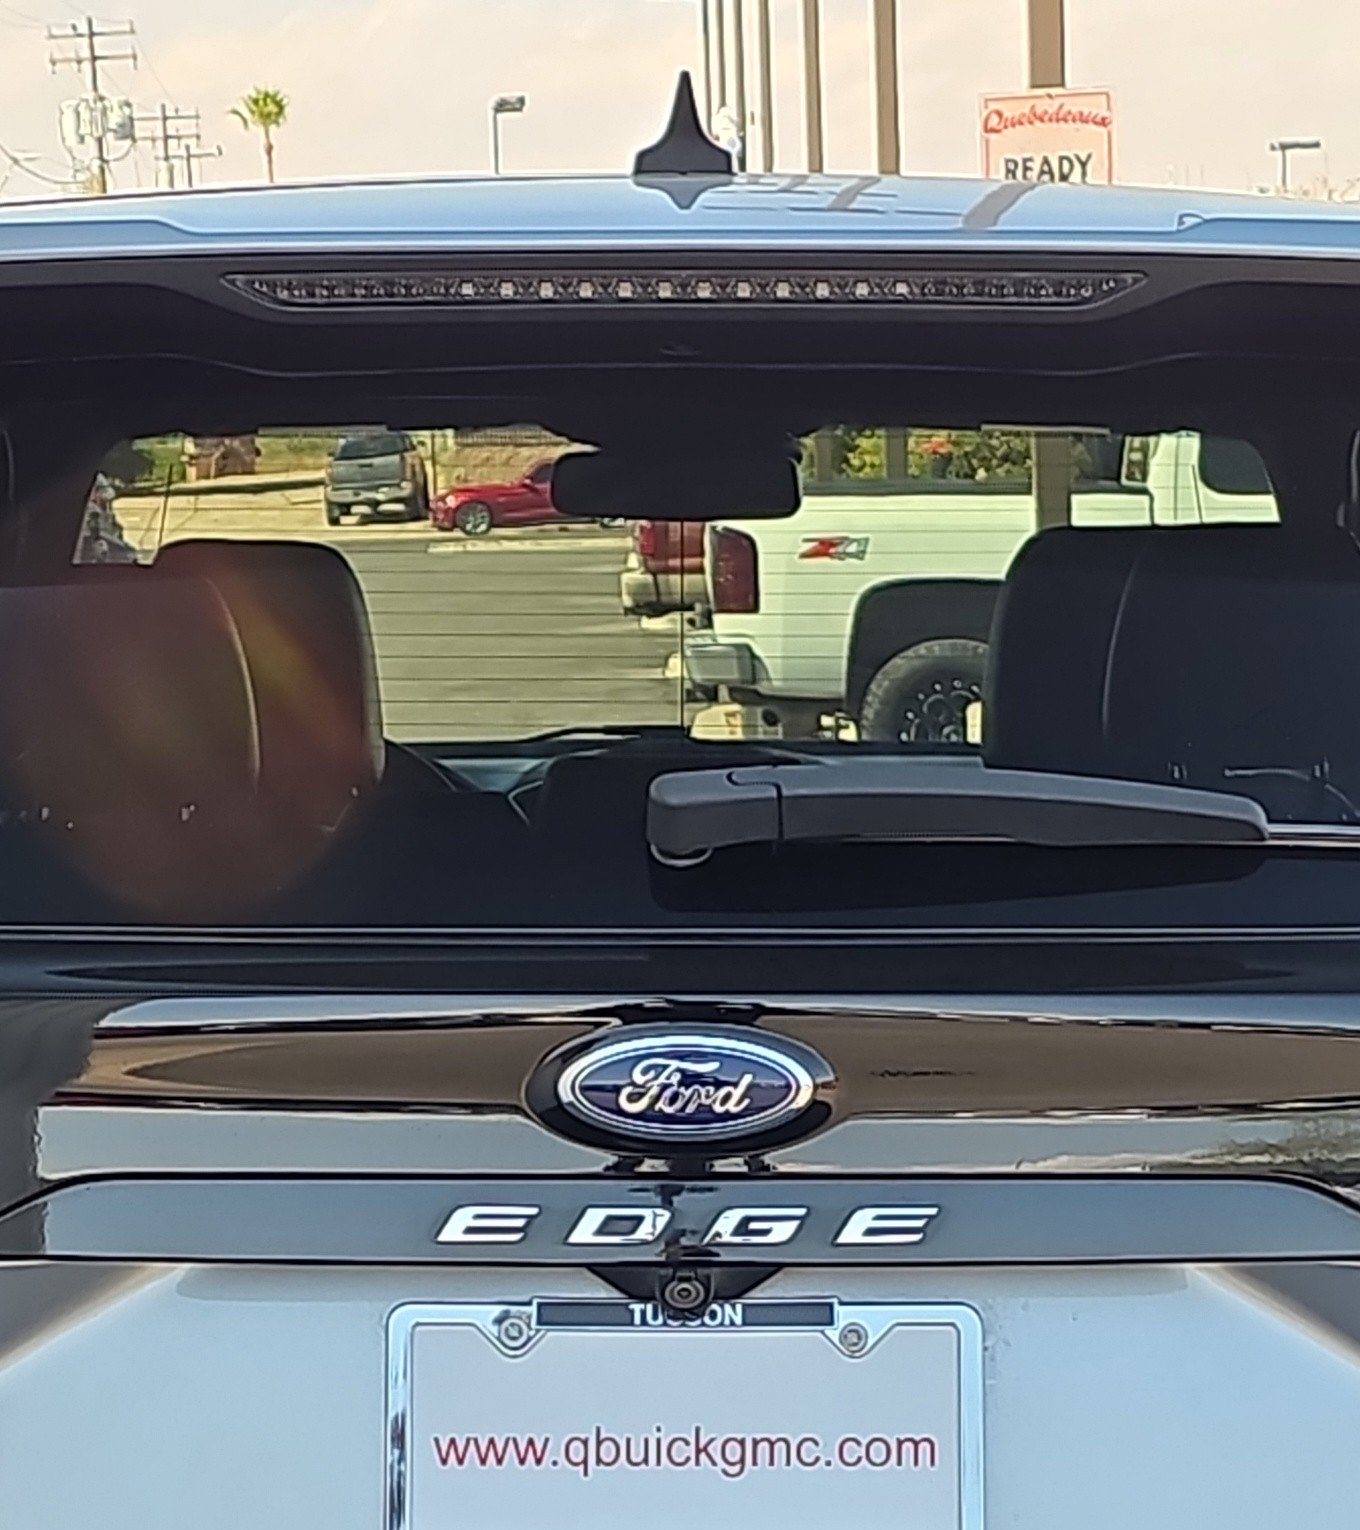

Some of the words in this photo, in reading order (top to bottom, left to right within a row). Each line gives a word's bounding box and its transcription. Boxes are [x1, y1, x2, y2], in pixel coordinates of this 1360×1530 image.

[983, 103, 1112, 134] Quebedeaux
[1004, 152, 1092, 184] READY
[617, 1057, 754, 1115] Ford
[436, 1205, 940, 1246] EDGE
[433, 1425, 937, 1478] www.qbuickgmc.com
